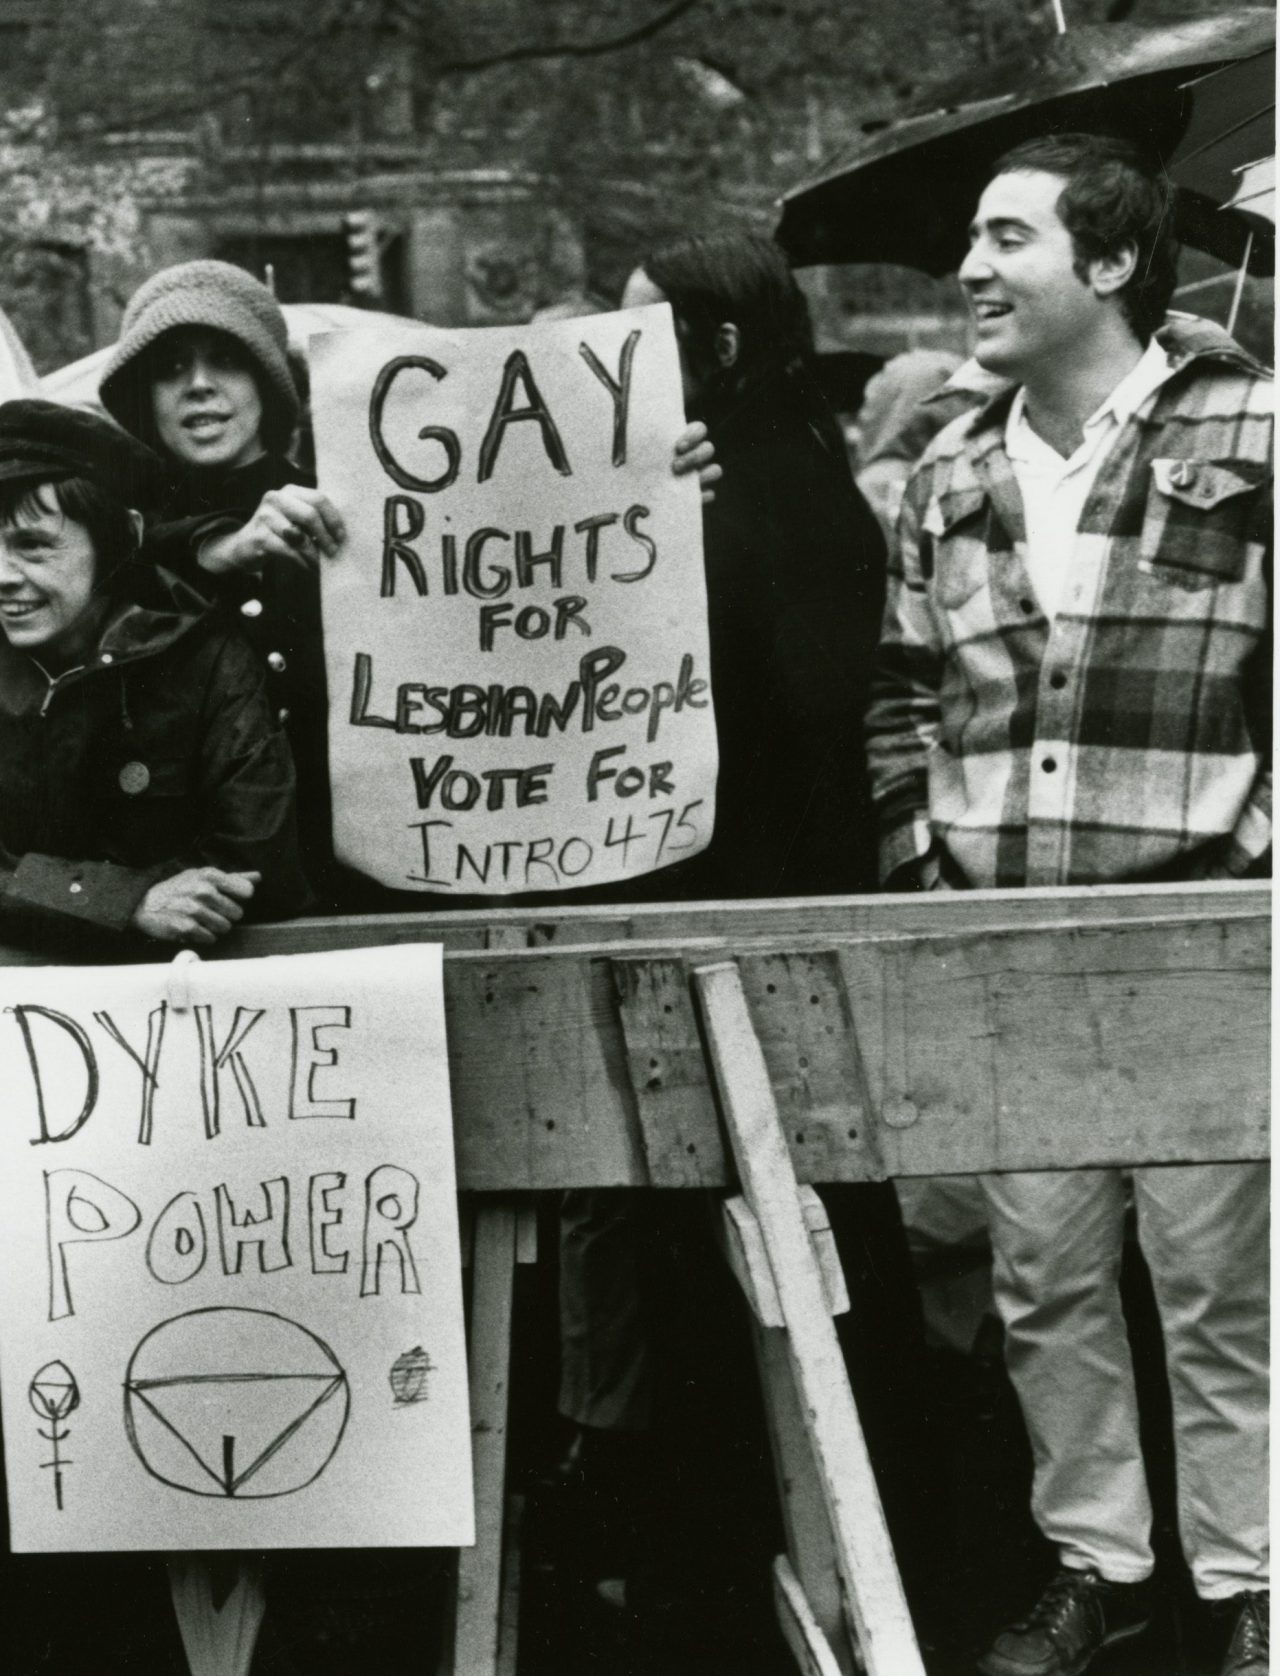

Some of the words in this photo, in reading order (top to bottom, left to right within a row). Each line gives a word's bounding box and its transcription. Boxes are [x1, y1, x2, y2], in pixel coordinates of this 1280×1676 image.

[369, 329, 641, 493] GAY
[480, 595, 591, 651] FOR
[350, 653, 581, 738] LESBIAN
[580, 646, 709, 742] People
[409, 755, 555, 811] VOTE
[587, 745, 676, 802] FOR
[406, 820, 593, 886] INTRO
[604, 799, 704, 869] 475
[3, 1000, 356, 1145] DYKE
[43, 1164, 421, 1322] POWER
